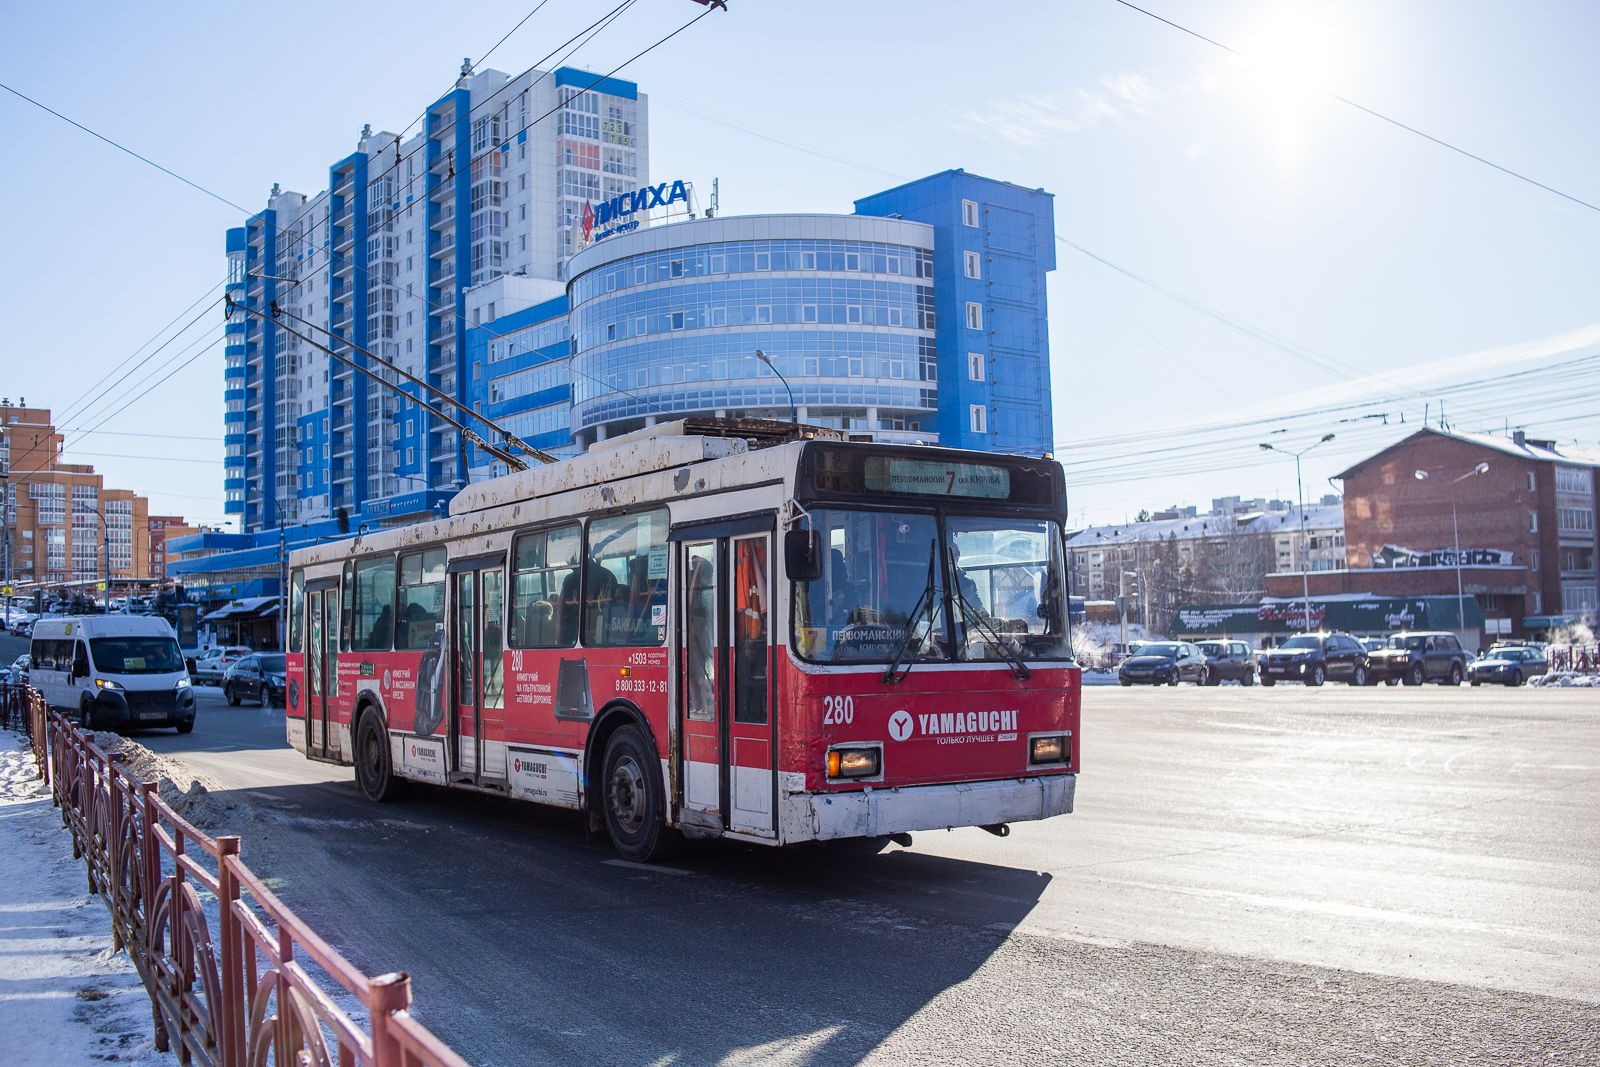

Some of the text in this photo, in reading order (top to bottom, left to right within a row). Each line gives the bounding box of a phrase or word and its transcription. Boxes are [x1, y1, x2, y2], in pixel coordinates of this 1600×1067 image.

[946, 471, 956, 494] 7
[970, 475, 1000, 484] КИРОВА
[511, 650, 524, 672] 280
[615, 679, 621, 691] 8
[620, 679, 634, 692] 800
[823, 695, 854, 725] 280
[918, 710, 1018, 735] YAMAGUCHI
[936, 736, 965, 745] ТОЛЬКО
[966, 734, 995, 744] ЛУЧШЕЕ
[521, 760, 548, 775] YAMAGUCHI
[523, 787, 548, 797] yamaguchi.ru
